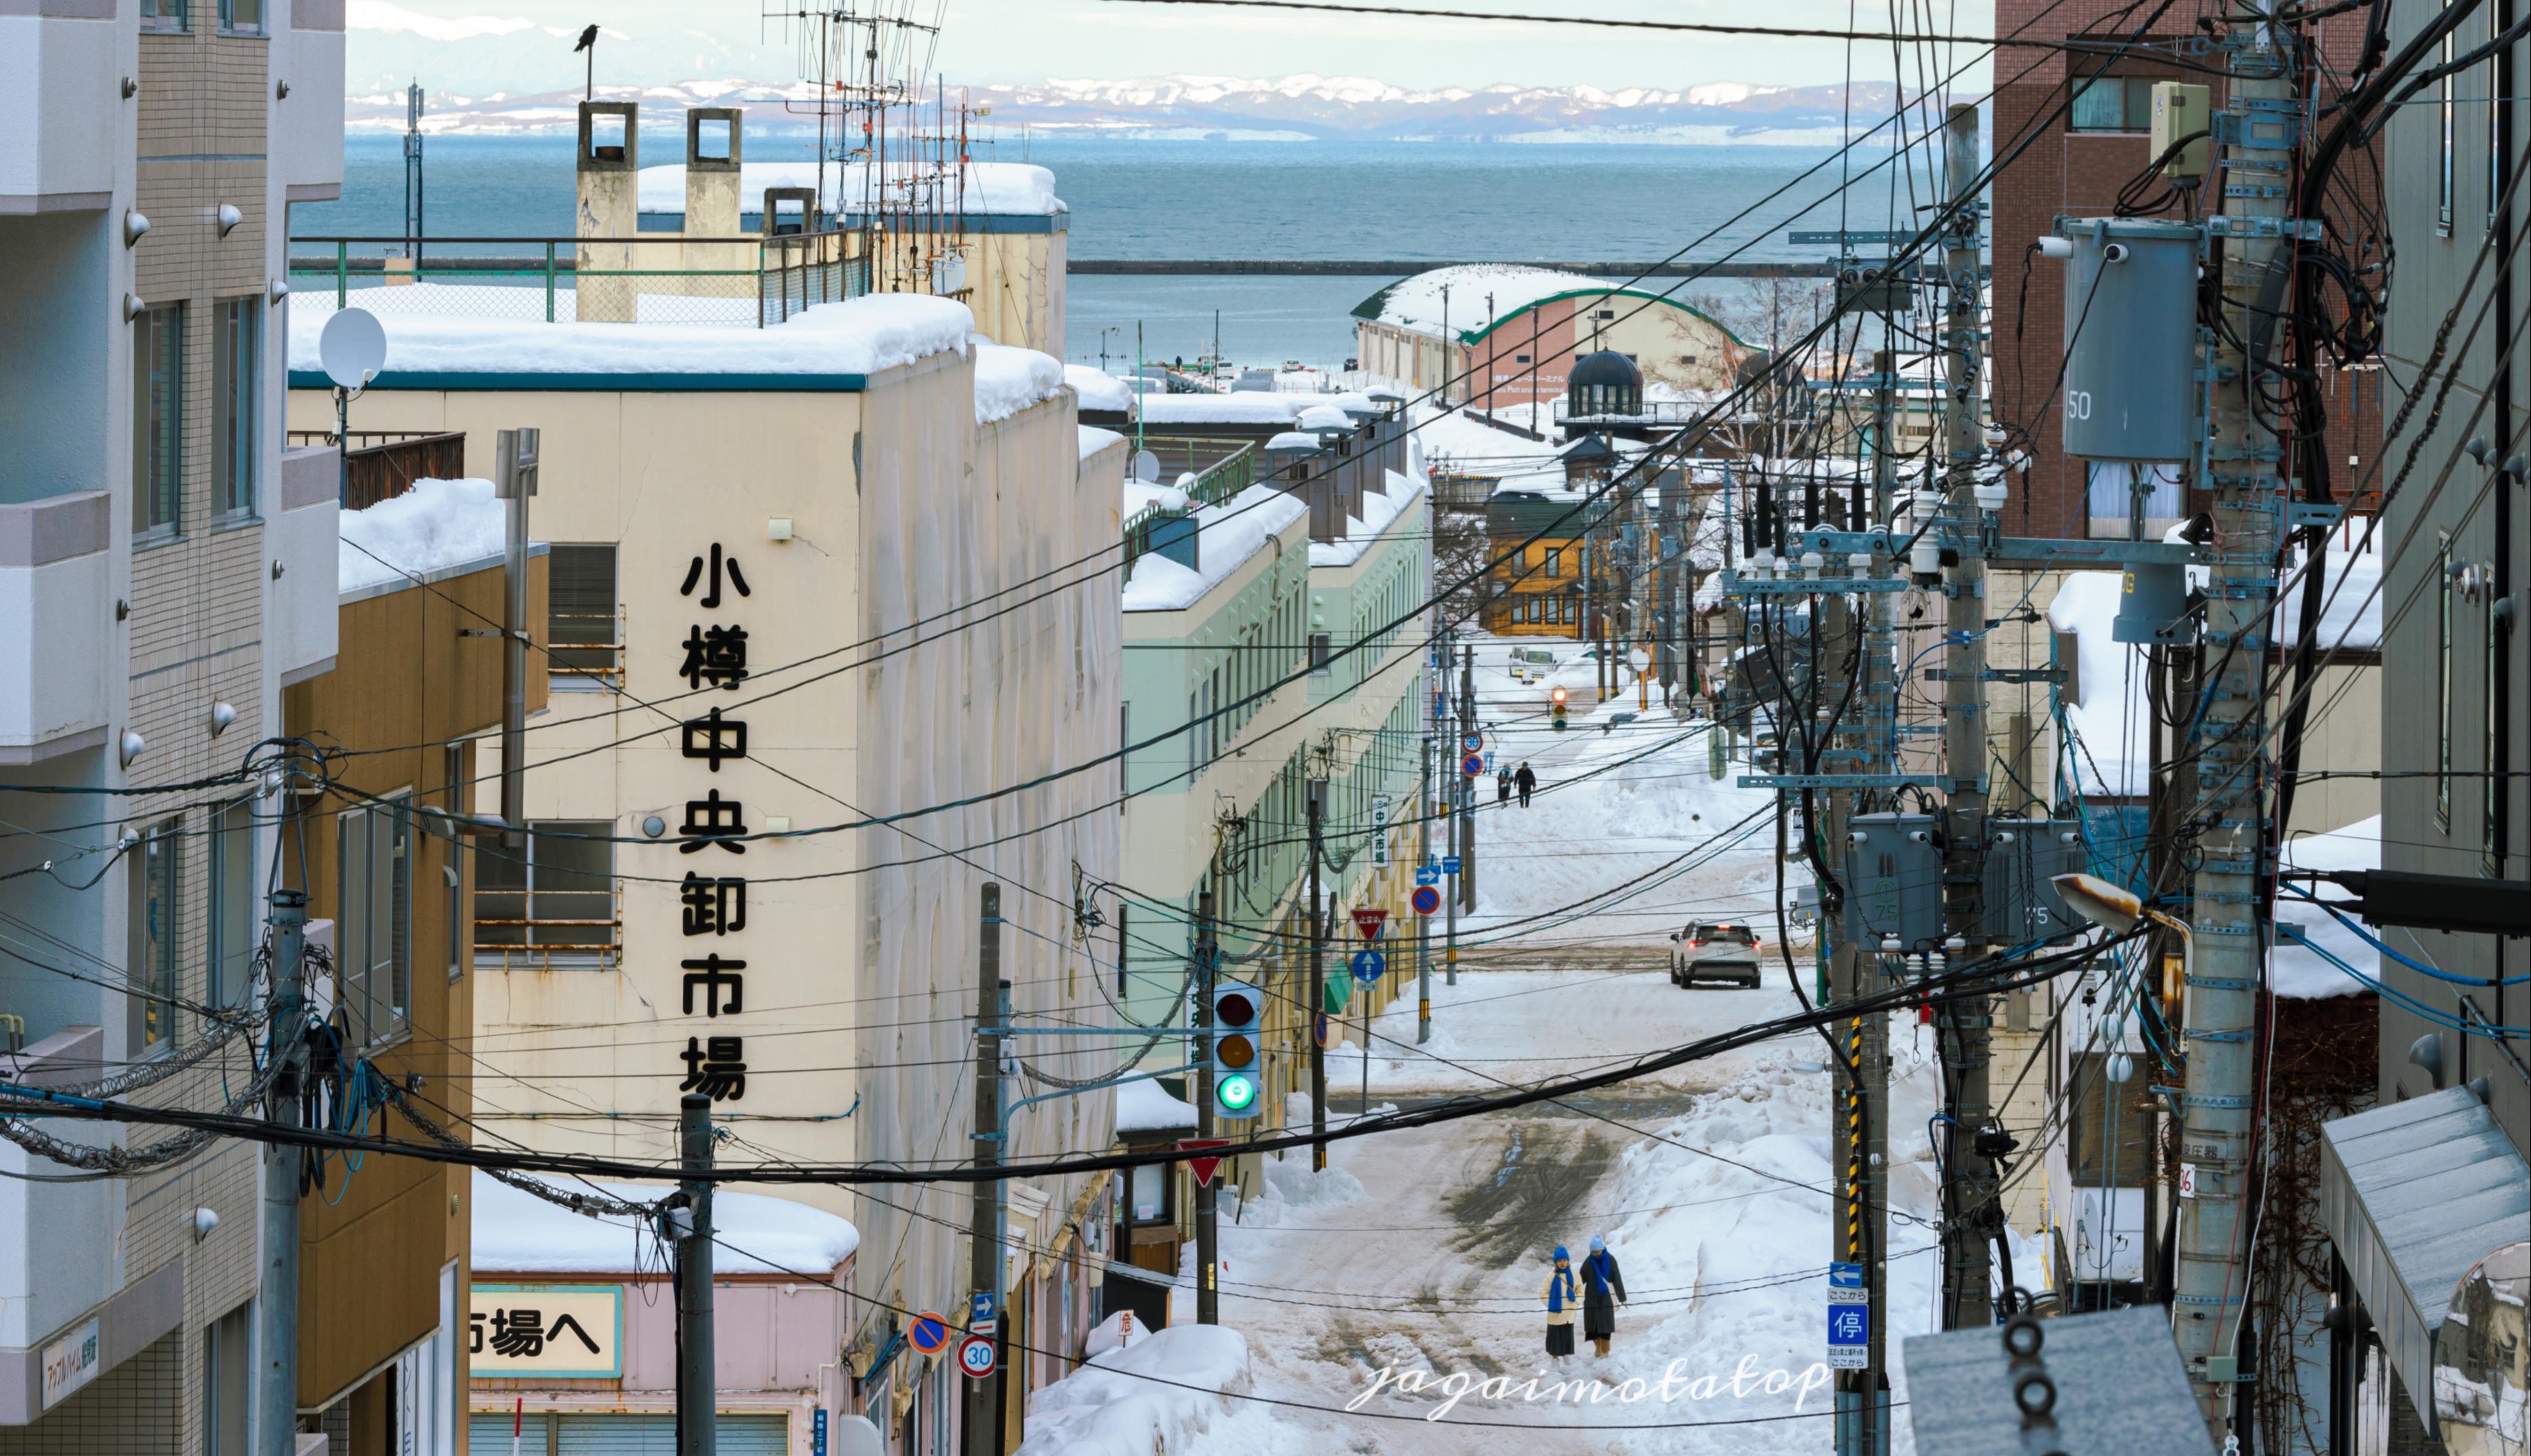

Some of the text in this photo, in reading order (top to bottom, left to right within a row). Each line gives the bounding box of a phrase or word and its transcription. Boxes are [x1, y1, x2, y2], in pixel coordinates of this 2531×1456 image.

[2068, 390, 2091, 420] 50
[679, 543, 750, 1101] 小樽中央卸市場
[1876, 905, 1897, 921] 75
[1830, 1292, 1866, 1300] ここから
[1835, 1312, 1862, 1337] 停
[967, 1347, 991, 1365] 30
